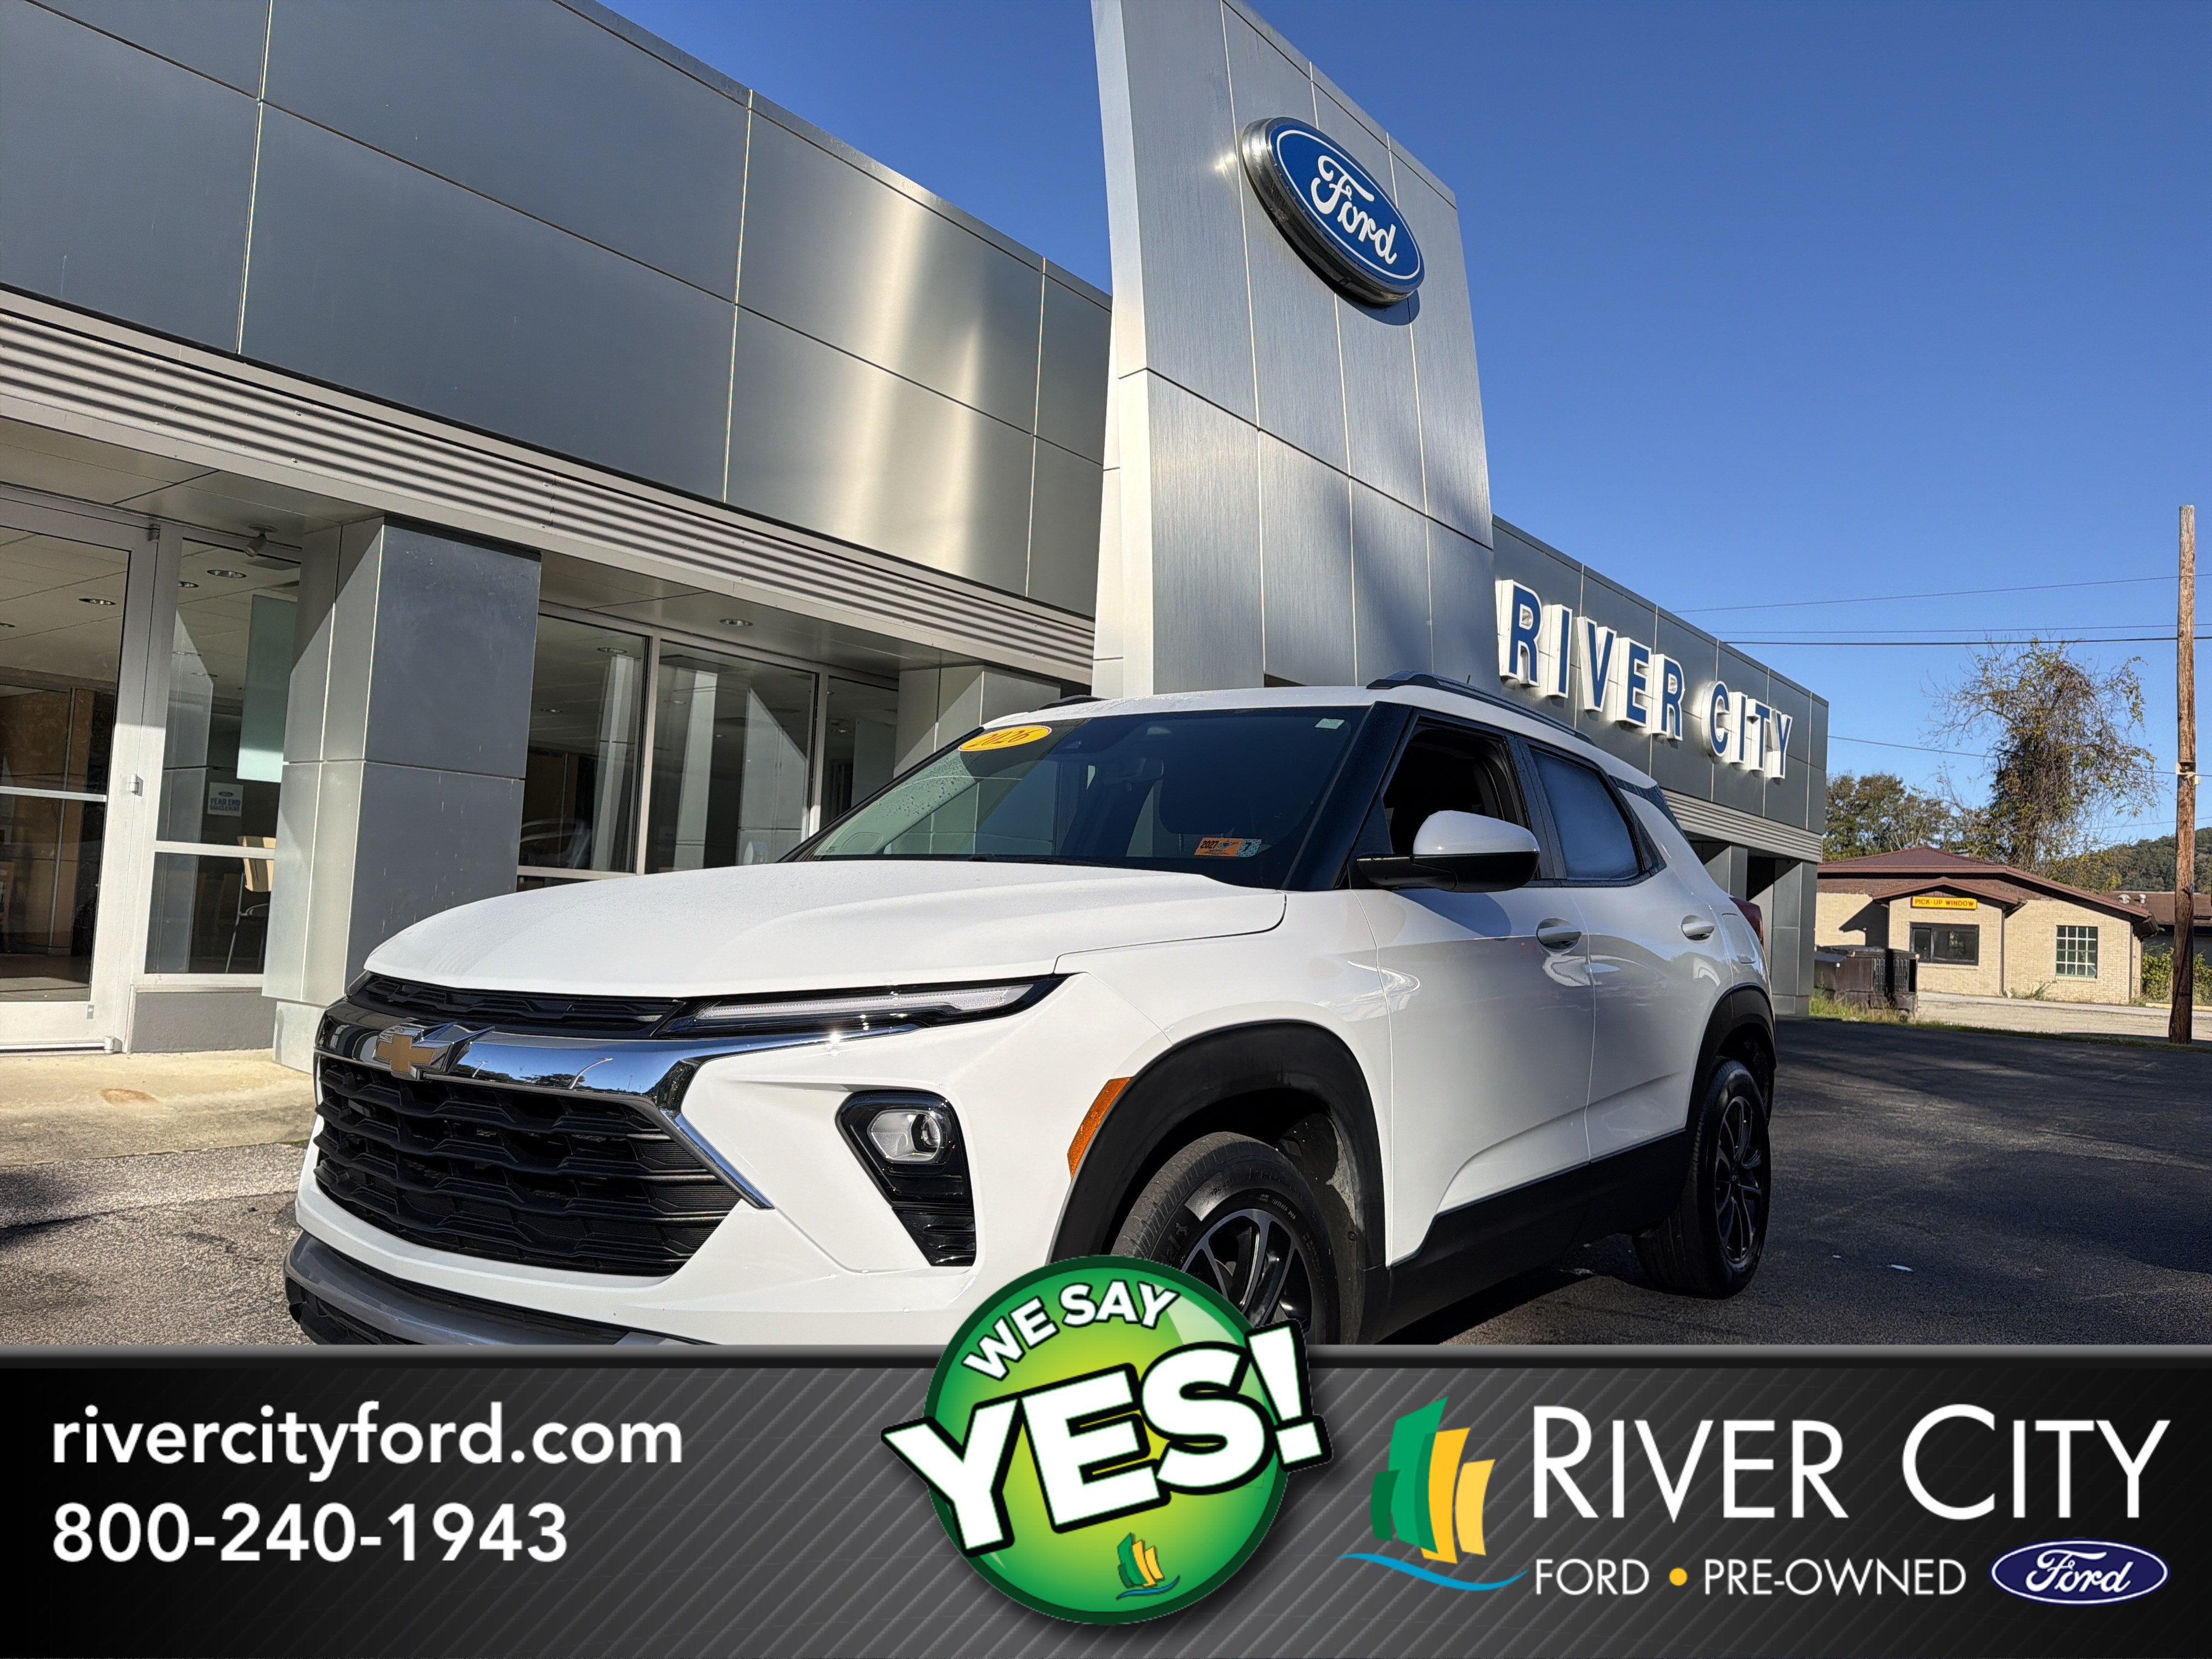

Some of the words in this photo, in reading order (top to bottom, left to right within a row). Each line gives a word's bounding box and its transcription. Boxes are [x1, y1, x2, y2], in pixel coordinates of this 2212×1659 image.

[1310, 155, 1398, 264] Ford
[1500, 579, 1685, 742] RIVER
[1702, 680, 1793, 780] CITY
[1199, 840, 1219, 849] 2027
[1242, 842, 1252, 852] 7
